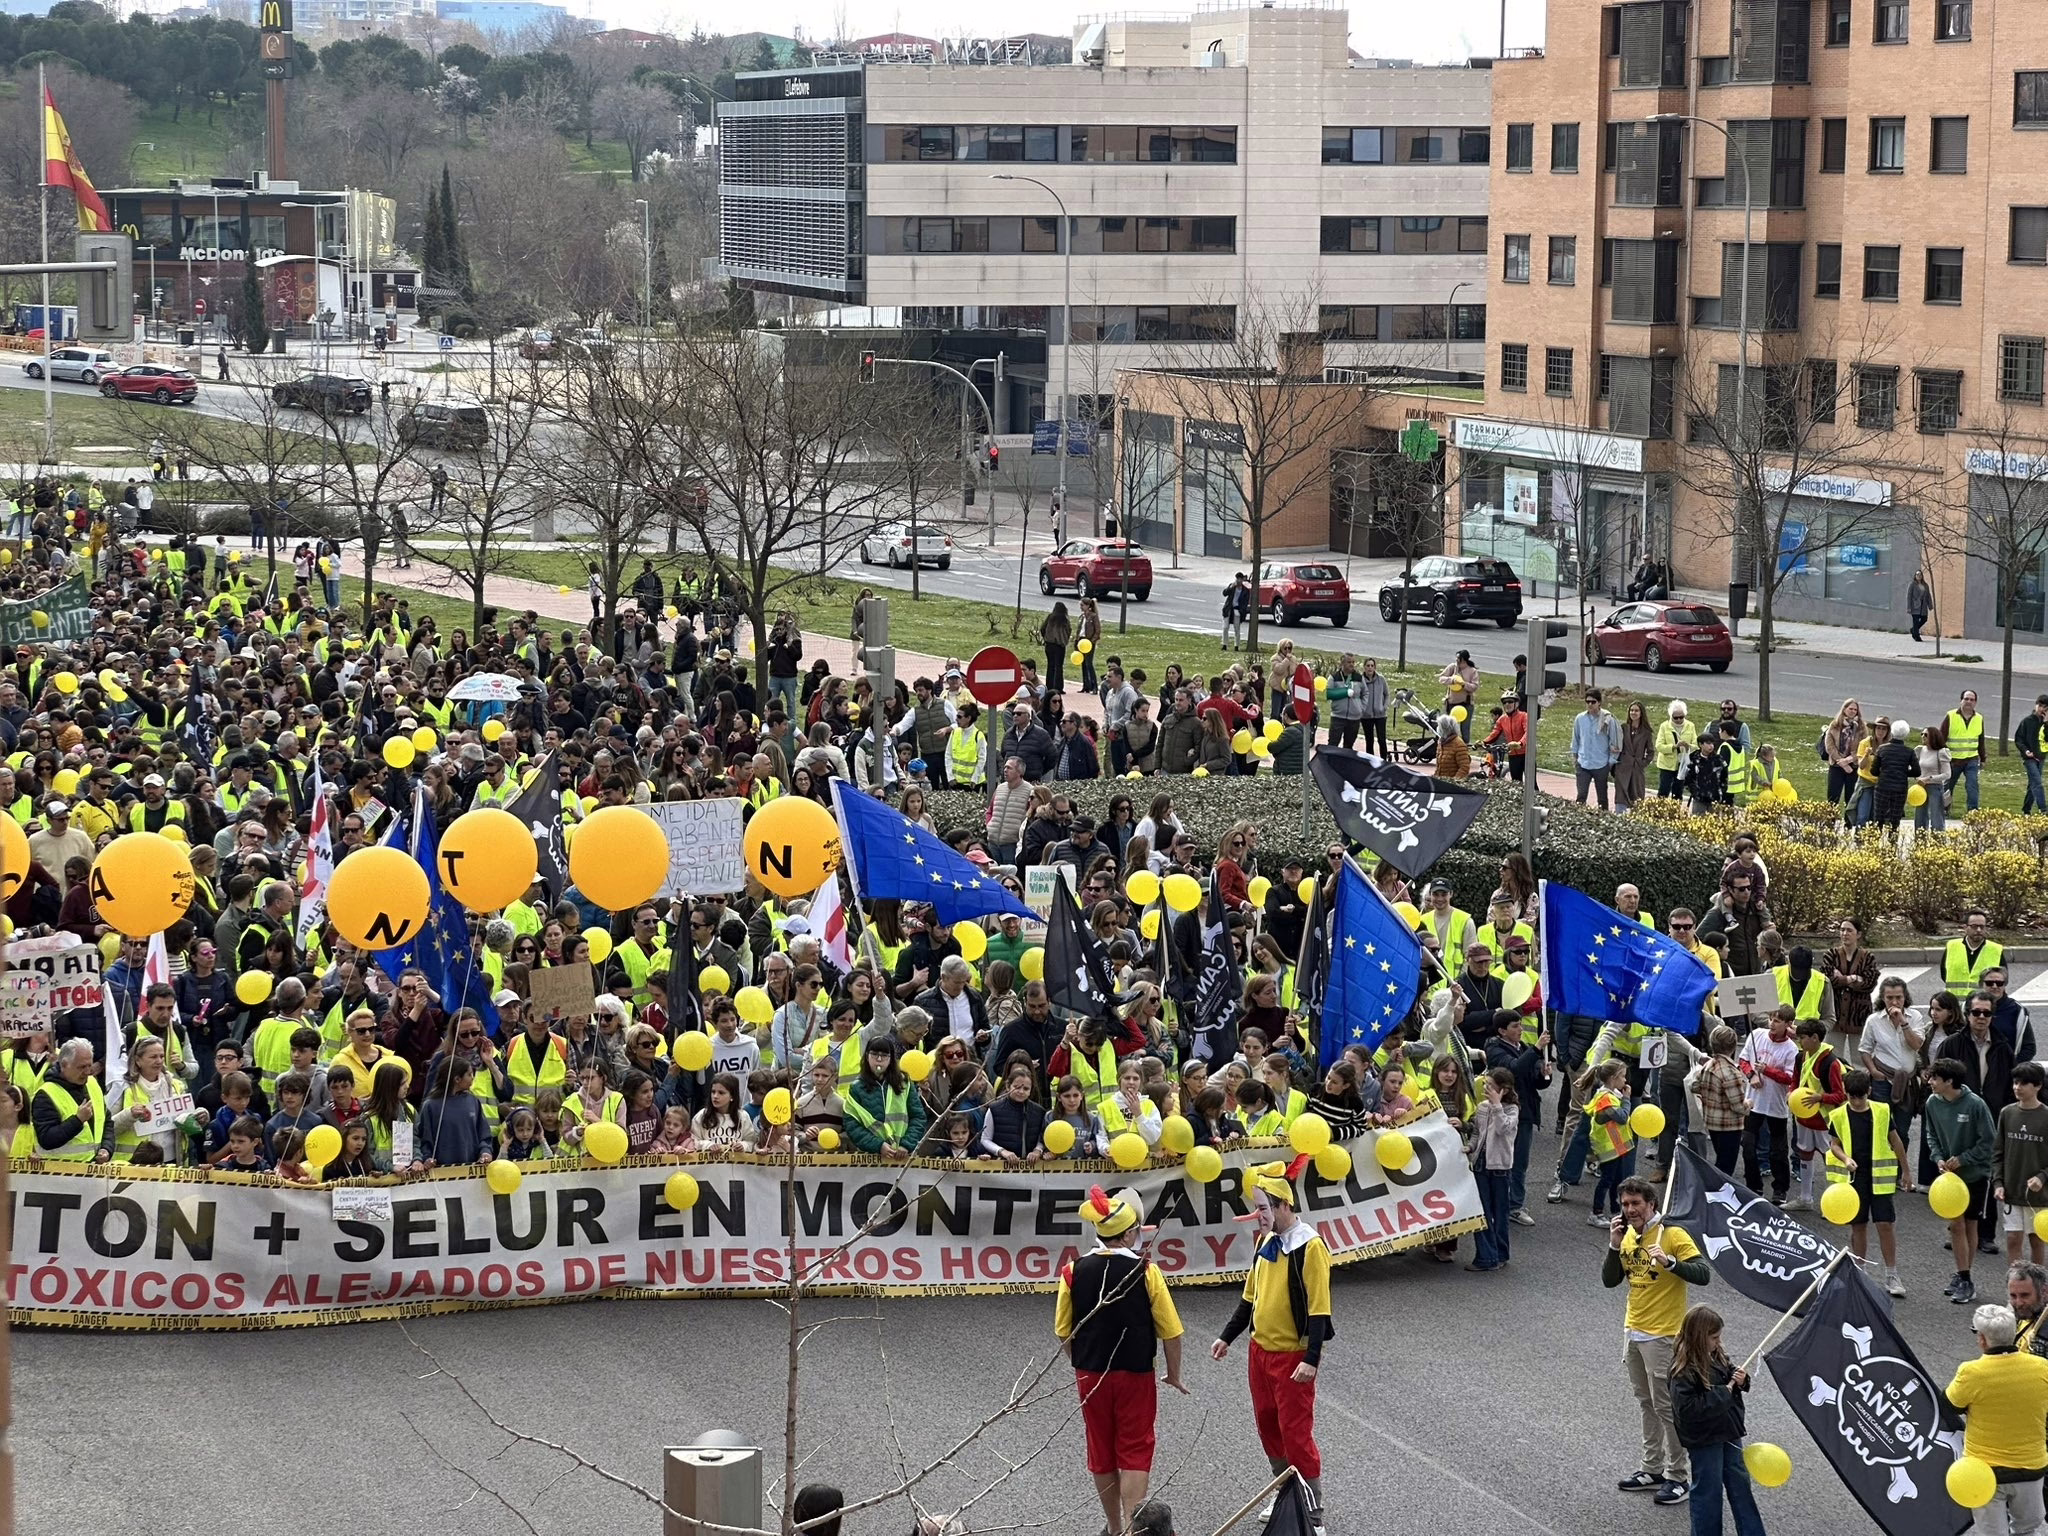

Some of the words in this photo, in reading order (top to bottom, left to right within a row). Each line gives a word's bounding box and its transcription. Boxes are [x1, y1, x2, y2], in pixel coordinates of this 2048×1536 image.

[180, 247, 285, 261] McDonld's
[1470, 424, 1510, 437] FARMACIA
[1823, 480, 1856, 496] Dental
[442, 851, 465, 886] T
[760, 841, 793, 878] N
[64, 954, 99, 975] AL
[154, 1095, 191, 1116] STOP
[629, 1118, 657, 1136] EVERLY
[631, 1130, 653, 1146] HILLS
[8, 1160, 46, 1171] TENTION
[87, 1164, 122, 1176] DANGER
[162, 1170, 210, 1180] ATTENTION
[550, 1158, 582, 1169] DANGER
[619, 1155, 663, 1165] ATTENTION
[769, 1155, 813, 1164] ATTETION
[851, 1154, 882, 1164] DANGER
[921, 1159, 965, 1169] ATTENTION
[1073, 1161, 1118, 1169] ATTENTION
[9, 1182, 217, 1261] TÓN
[333, 1188, 609, 1262] SELUR
[638, 1180, 746, 1241] EN
[780, 1136, 1437, 1237] MONTEARELO
[1768, 1216, 1787, 1227] NO
[1354, 1243, 1394, 1258] ATTENTION
[1423, 1227, 1450, 1241] DANGER
[1726, 1216, 1837, 1261] CANTÓN
[1751, 1234, 1803, 1255] MONTECARMELO
[6, 1257, 245, 1310] TÓXICOS
[263, 1261, 546, 1308] ALEJADOS
[563, 1254, 627, 1293] DE
[645, 1247, 923, 1285] NUESTROS
[941, 1238, 1187, 1280] HOGAS
[1203, 1233, 1237, 1268] Y
[1253, 1190, 1455, 1250] MILIAS
[1760, 1248, 1786, 1260] MADRID
[615, 1288, 661, 1300] ATTENTION
[700, 1291, 732, 1299] DANGER
[771, 1288, 816, 1297] ATTEION
[853, 1285, 886, 1295] DANGER
[923, 1286, 967, 1295] ATTENTION
[1003, 1284, 1036, 1293] DANGER
[1219, 1272, 1250, 1282] ATTENT
[8, 1311, 33, 1321] NTION
[73, 1314, 108, 1325] DANGER
[150, 1317, 200, 1327] ATTENTION
[241, 1316, 276, 1327] DANGER
[316, 1310, 361, 1321] ATTENTION
[400, 1304, 432, 1315] DANGER
[1883, 1382, 1901, 1400] NO
[1897, 1400, 1914, 1415] AL
[1844, 1363, 1933, 1461] CANTÓN
[1855, 1401, 1894, 1445] MONTECARMELO
[1857, 1420, 1876, 1443] MADRID
